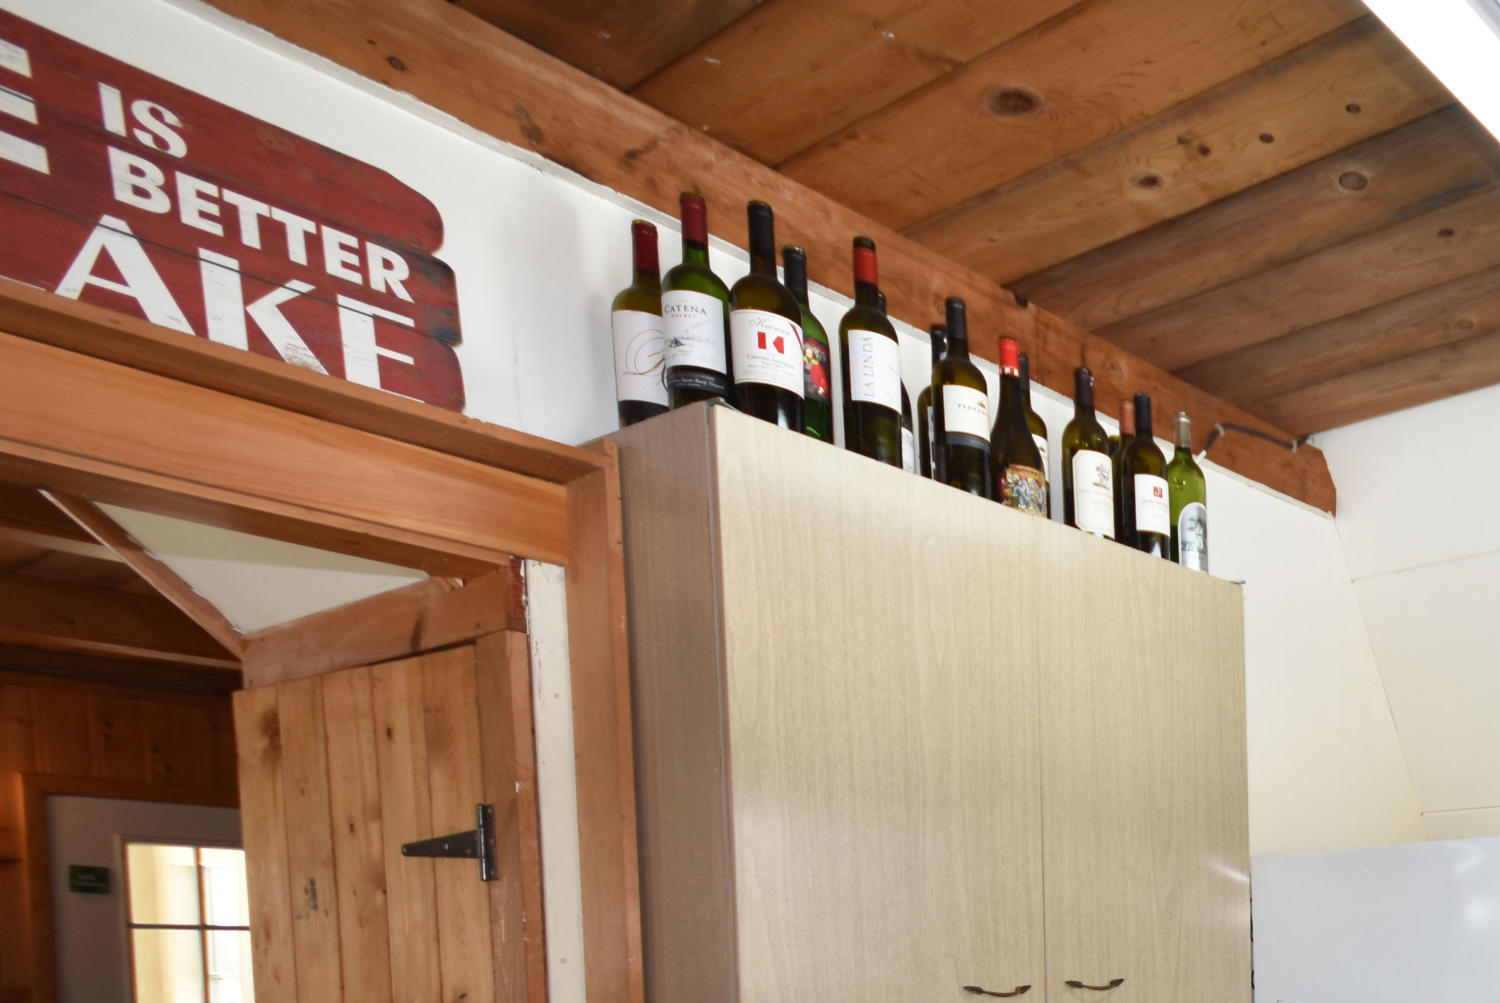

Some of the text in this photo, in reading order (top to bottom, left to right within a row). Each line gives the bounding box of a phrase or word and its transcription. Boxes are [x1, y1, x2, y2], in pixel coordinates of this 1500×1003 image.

[97, 81, 188, 159] IS
[106, 145, 415, 304] BETTER
[664, 304, 708, 316] CATENA
